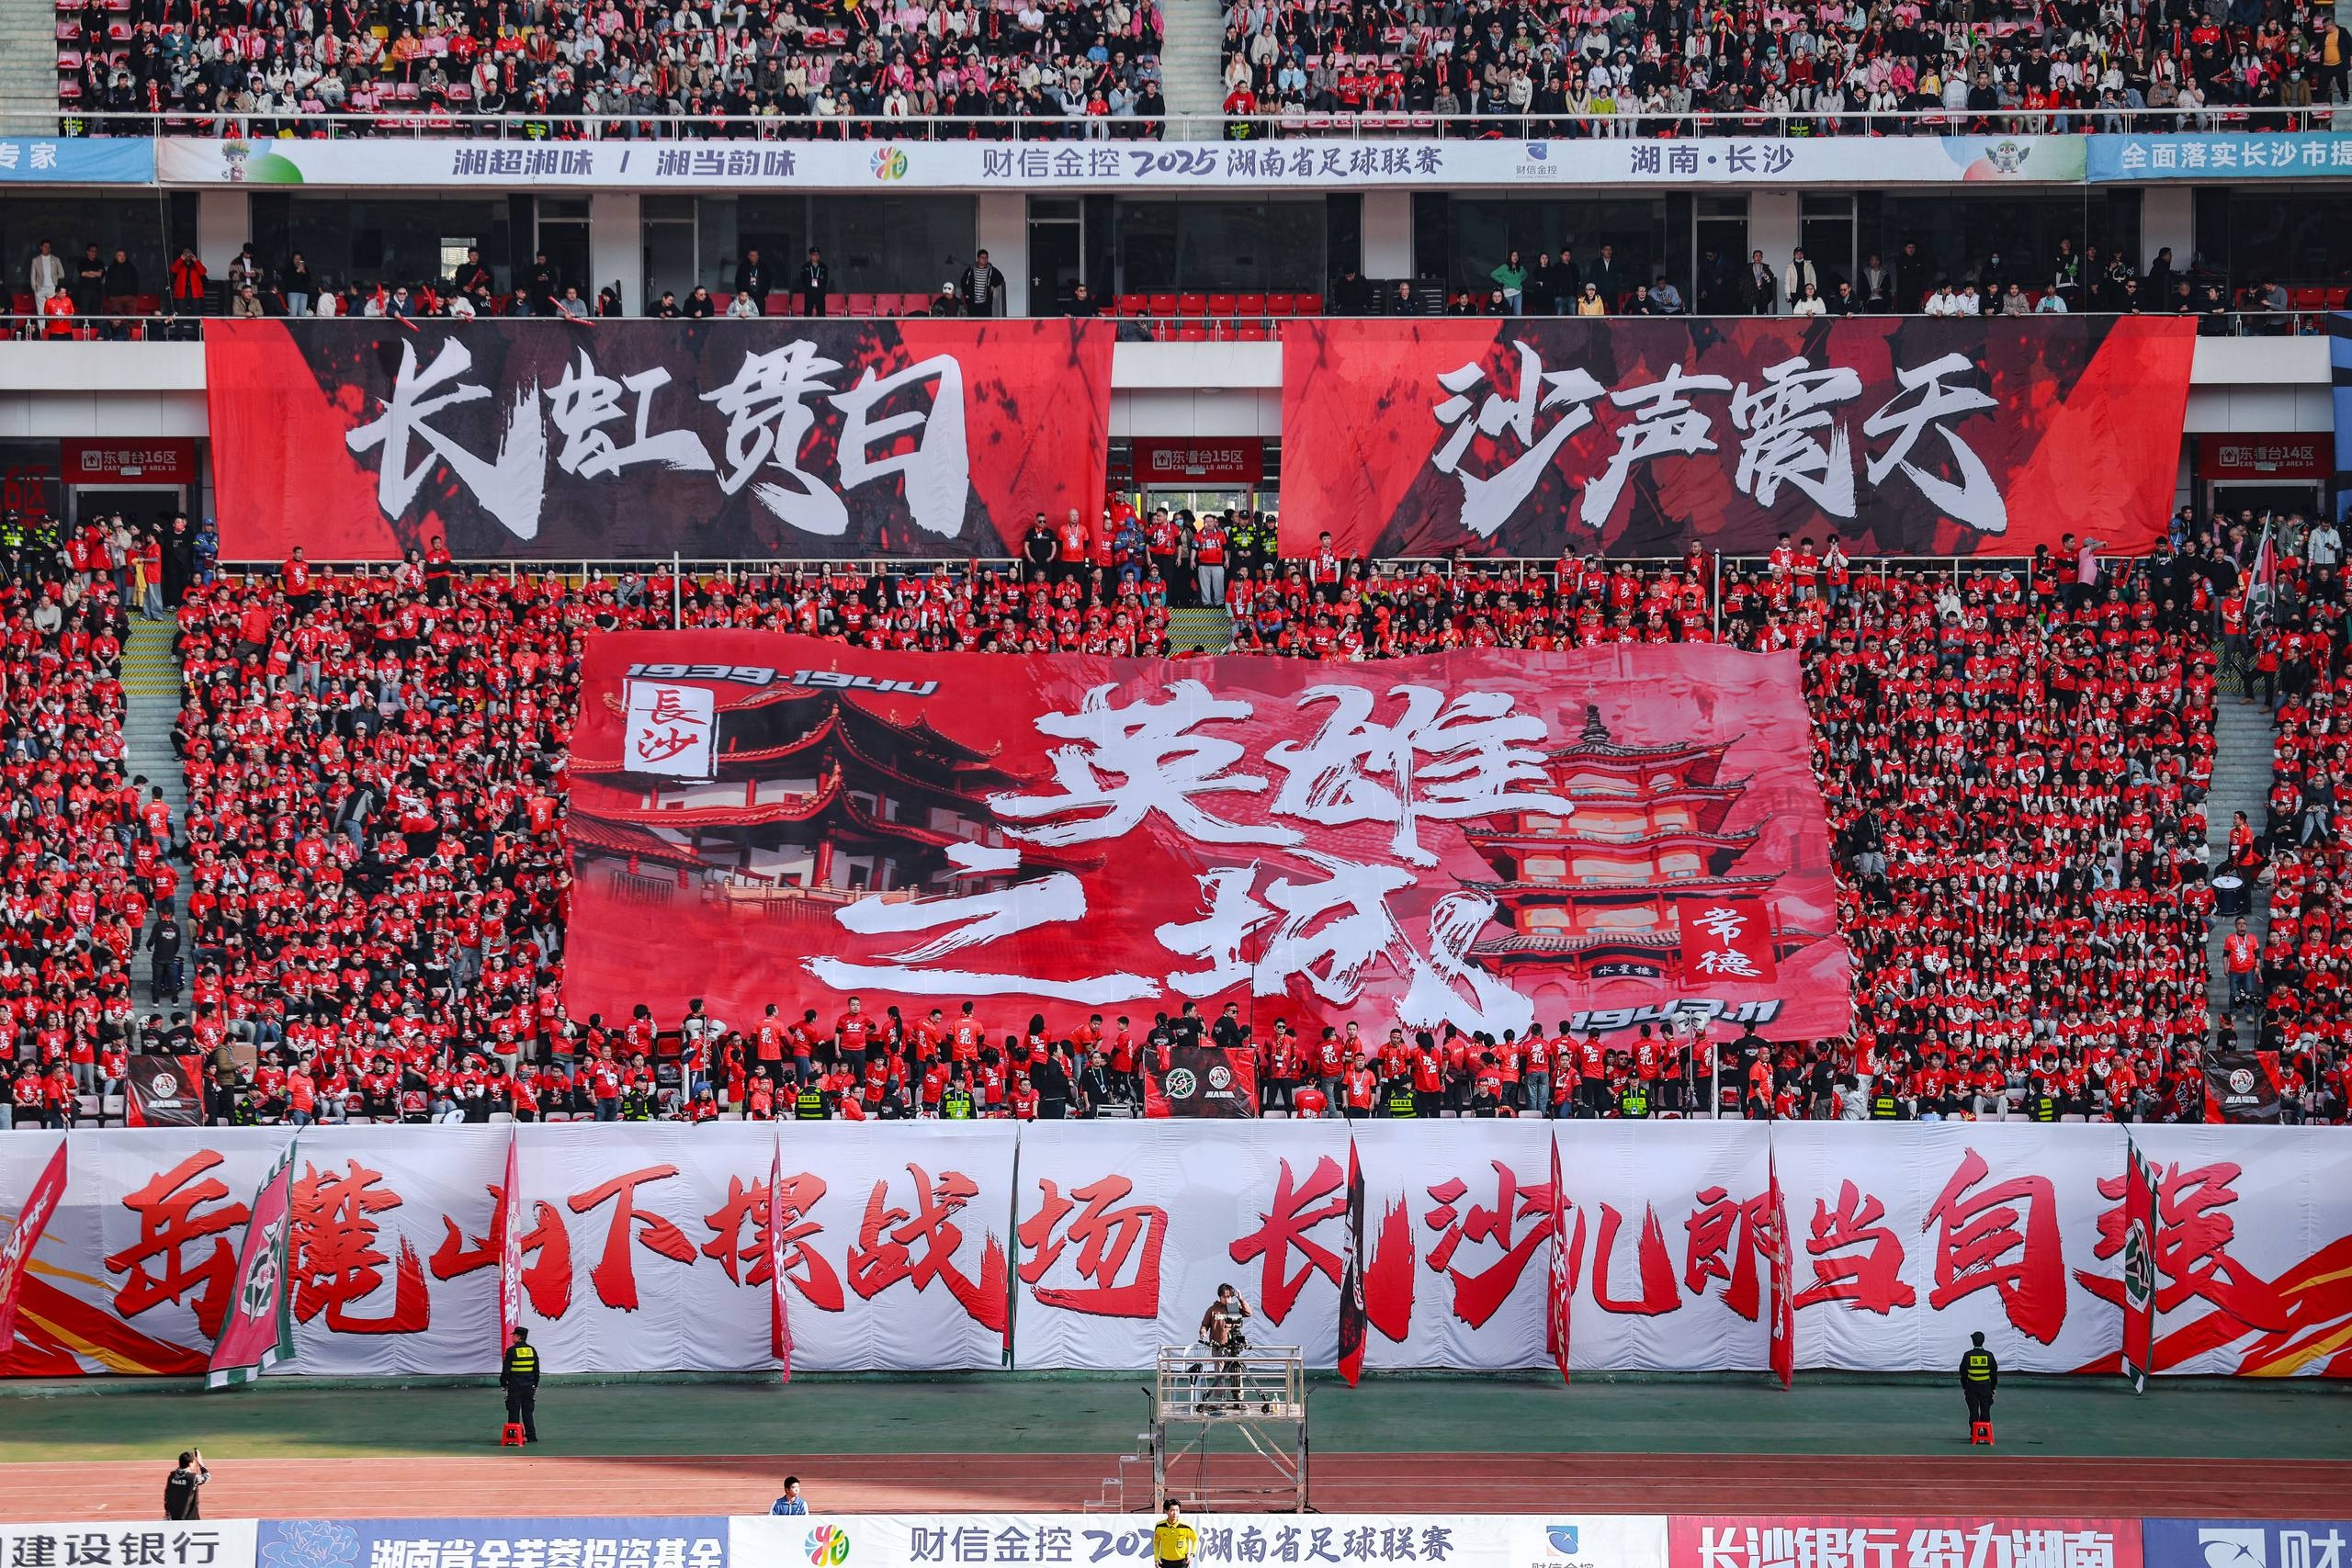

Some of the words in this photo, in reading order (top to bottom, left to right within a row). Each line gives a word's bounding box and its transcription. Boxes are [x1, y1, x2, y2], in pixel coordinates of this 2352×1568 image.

[0, 142, 57, 169] 专家
[452, 149, 594, 175] 湘超湘味
[620, 150, 631, 174] /
[656, 150, 796, 176] 湘当韵味
[983, 147, 1120, 177] 财信金控
[1128, 149, 1219, 177] 2025
[1227, 146, 1442, 177] 湖南省足球联赛
[1516, 165, 1557, 175] 财信金控
[1630, 145, 1794, 174] 湖南·长沙
[2122, 141, 2352, 169] 全面落实长沙市提
[345, 336, 969, 541] 长虹贯日
[1432, 340, 2007, 537] 沙声震天
[2240, 446, 2314, 459] 东看台14区
[103, 451, 176, 464] 东看台16区
[1172, 450, 1243, 463] 东看台15区
[626, 664, 939, 695] 1939-1944
[635, 689, 707, 763] 長沙
[985, 679, 1575, 867] 英雄
[799, 840, 1535, 1035] 之城
[1692, 907, 1764, 976] 常德
[1572, 998, 1781, 1032] 1943.11
[0, 1530, 220, 1568] 建设银行
[910, 1526, 1072, 1562] 财信金控
[1082, 1529, 1155, 1563] 202
[1199, 1525, 1453, 1563] 湖南省足球联赛
[1697, 1528, 1899, 1568] 长沙银行
[1908, 1522, 2113, 1568] 给力湖南
